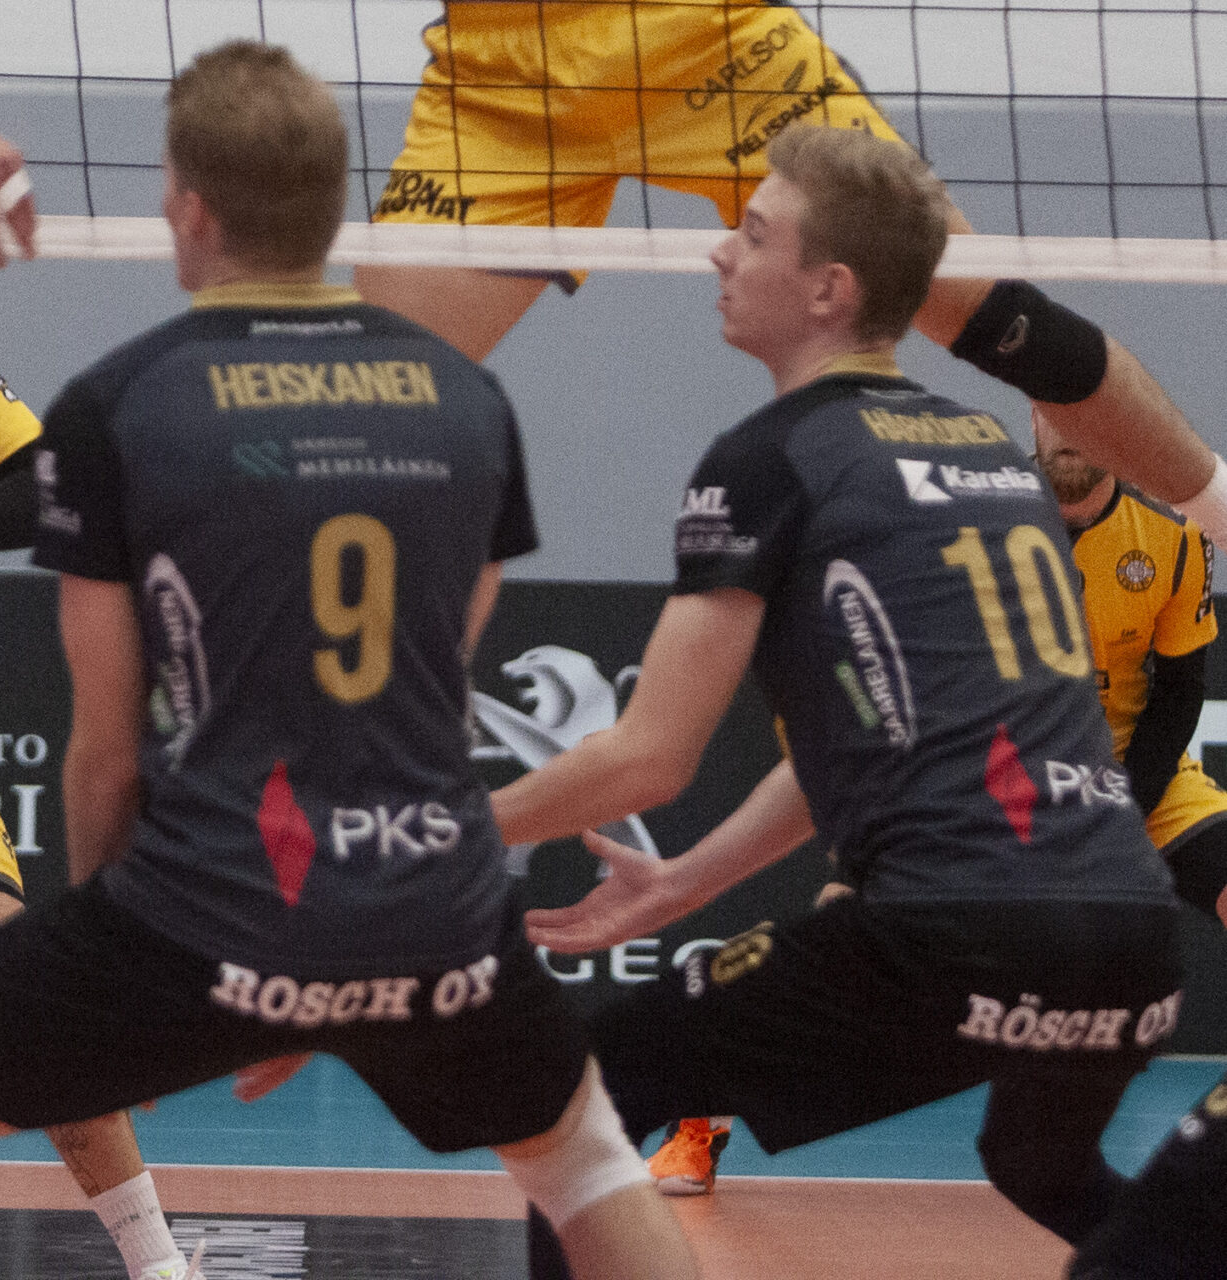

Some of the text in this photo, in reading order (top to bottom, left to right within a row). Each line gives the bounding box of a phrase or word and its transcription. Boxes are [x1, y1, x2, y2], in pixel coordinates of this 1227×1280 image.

[207, 360, 440, 410] HEISKANEN
[938, 463, 1042, 491] Karelia
[309, 512, 398, 706] 9
[940, 523, 1094, 681] 10
[1044, 759, 1133, 807] PKS
[330, 802, 462, 861] PKS
[956, 991, 1132, 1052] RÖSCH
